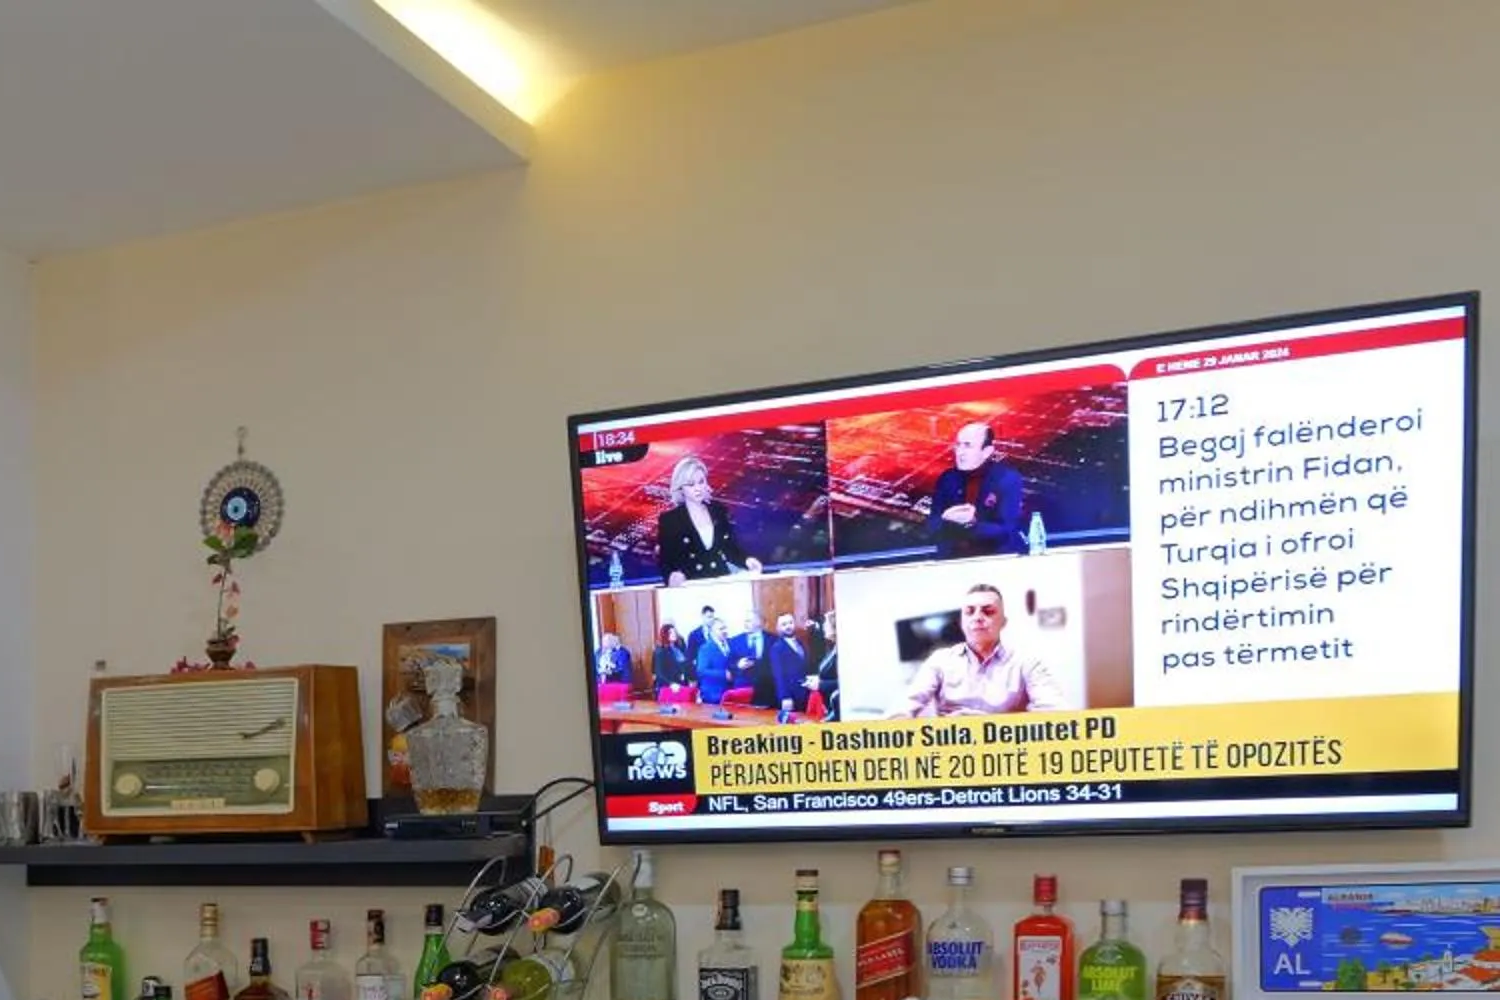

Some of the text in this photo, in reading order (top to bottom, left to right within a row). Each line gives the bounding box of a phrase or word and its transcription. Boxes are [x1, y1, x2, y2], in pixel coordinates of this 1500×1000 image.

[1157, 394, 1229, 422] 17:12
[1159, 408, 1423, 462] Begaj falënderoi
[595, 450, 623, 464] live
[1159, 454, 1403, 494] ministrin Fidan,
[1161, 486, 1409, 535] për ndihmën që
[1161, 527, 1354, 566] Turqia i ofroi
[1161, 562, 1393, 600] Shqipërisë për
[1161, 603, 1335, 635] rindërtimin
[1162, 637, 1354, 674] pas tërmetit
[707, 731, 801, 757] Breaking
[821, 726, 914, 752] Dashnor
[984, 719, 1080, 745] Deputet
[1085, 716, 1116, 739] PD
[627, 764, 687, 781] news
[711, 735, 1343, 787] PËRJASHTOHEN DERI NË 20 DITË 19 DEPUTETË TË OPOZITËS
[649, 801, 684, 814] Sport
[708, 783, 1122, 813] NFL, San Francisco 49ers-Detroit Lions 34-31
[928, 941, 983, 955] ABSOLUT
[1273, 953, 1311, 976] AL
